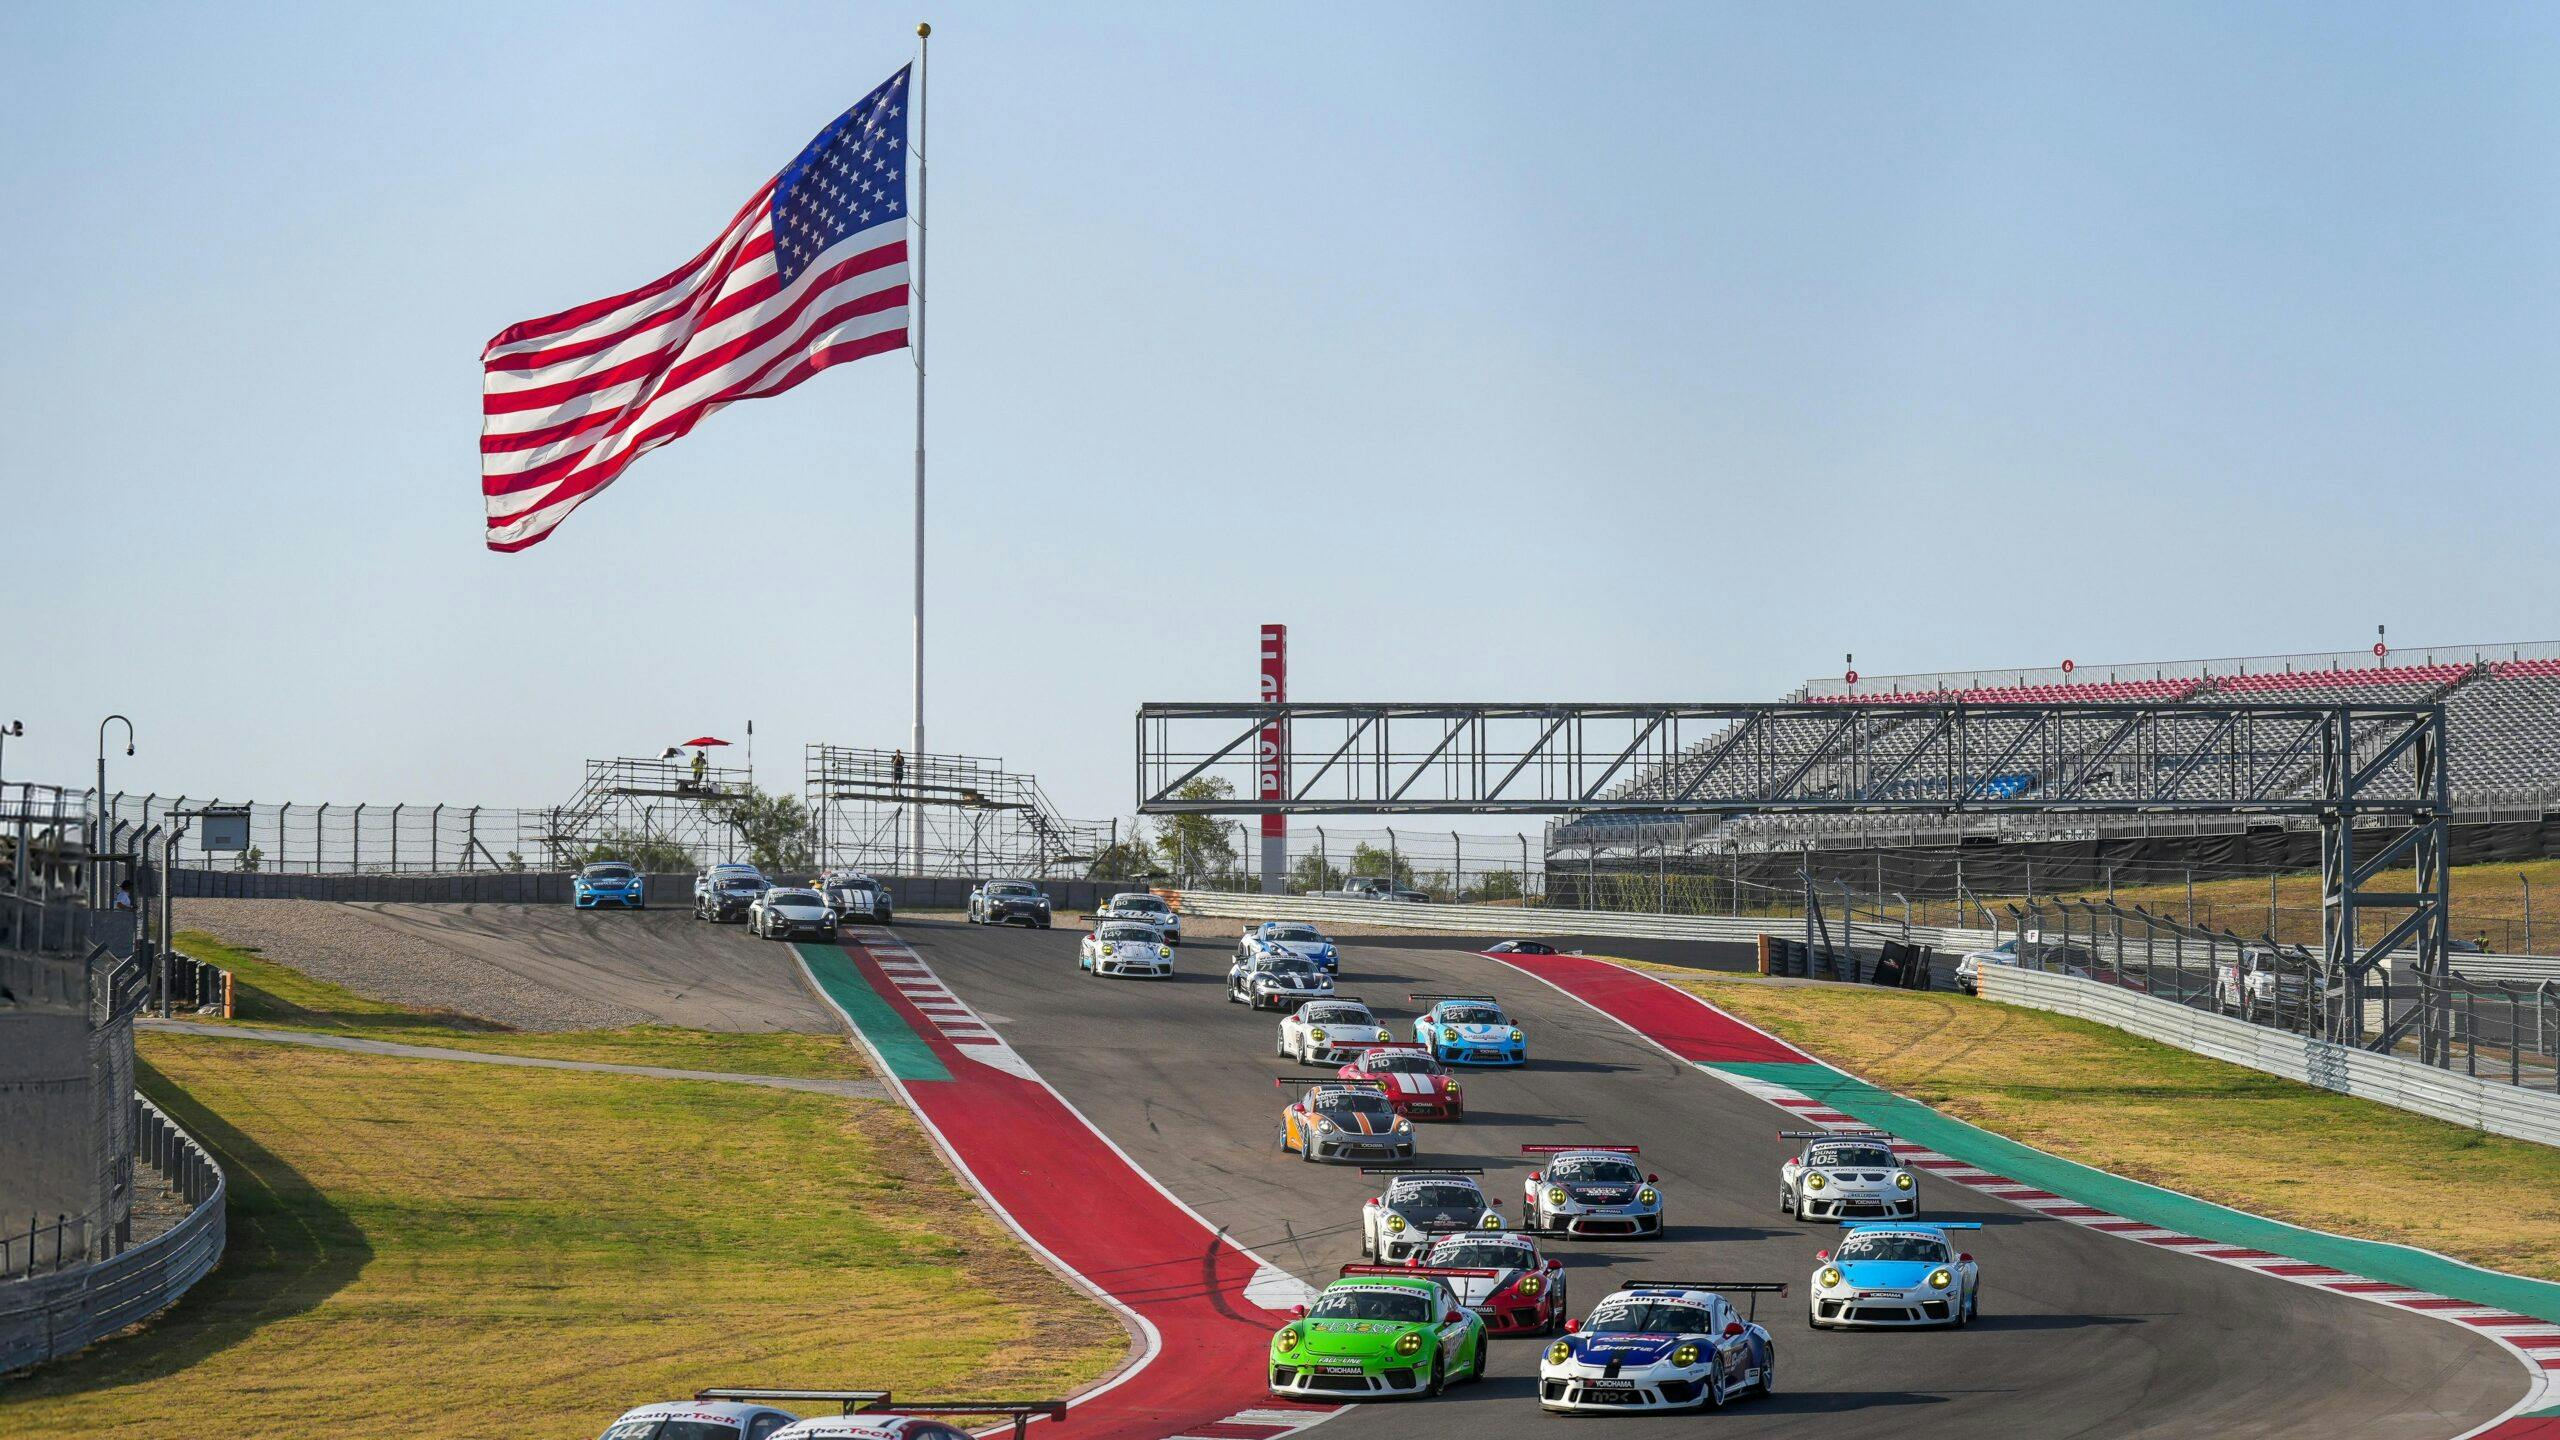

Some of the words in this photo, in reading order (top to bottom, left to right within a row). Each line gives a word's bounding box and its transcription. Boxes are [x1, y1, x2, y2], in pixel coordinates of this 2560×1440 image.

[1103, 931, 1122, 939] 149
[1309, 1011, 1331, 1020] 125
[1445, 1012, 1465, 1021] 121
[1369, 1059, 1390, 1069] 110
[1316, 1099, 1339, 1109] 119
[1816, 1143, 1888, 1151] WeatherTech
[1557, 1156, 1634, 1165] WeatherTech
[1810, 1155, 1838, 1166] 105
[1553, 1164, 1581, 1176] 102
[1390, 1190, 1419, 1203] 156
[1849, 1231, 1941, 1241] WeatherTech
[1437, 1240, 1529, 1249] WeatherTech
[1841, 1242, 1874, 1255] 196
[1428, 1250, 1460, 1265] 127
[1328, 1285, 1428, 1297] WeatherTech
[1316, 1297, 1348, 1312] 114
[1602, 1297, 1708, 1308] WeatherTech
[1591, 1310, 1628, 1325] 122
[620, 1412, 736, 1425] WeatherTech
[610, 1424, 655, 1440] 144
[770, 1427, 897, 1440] WeatherTech
